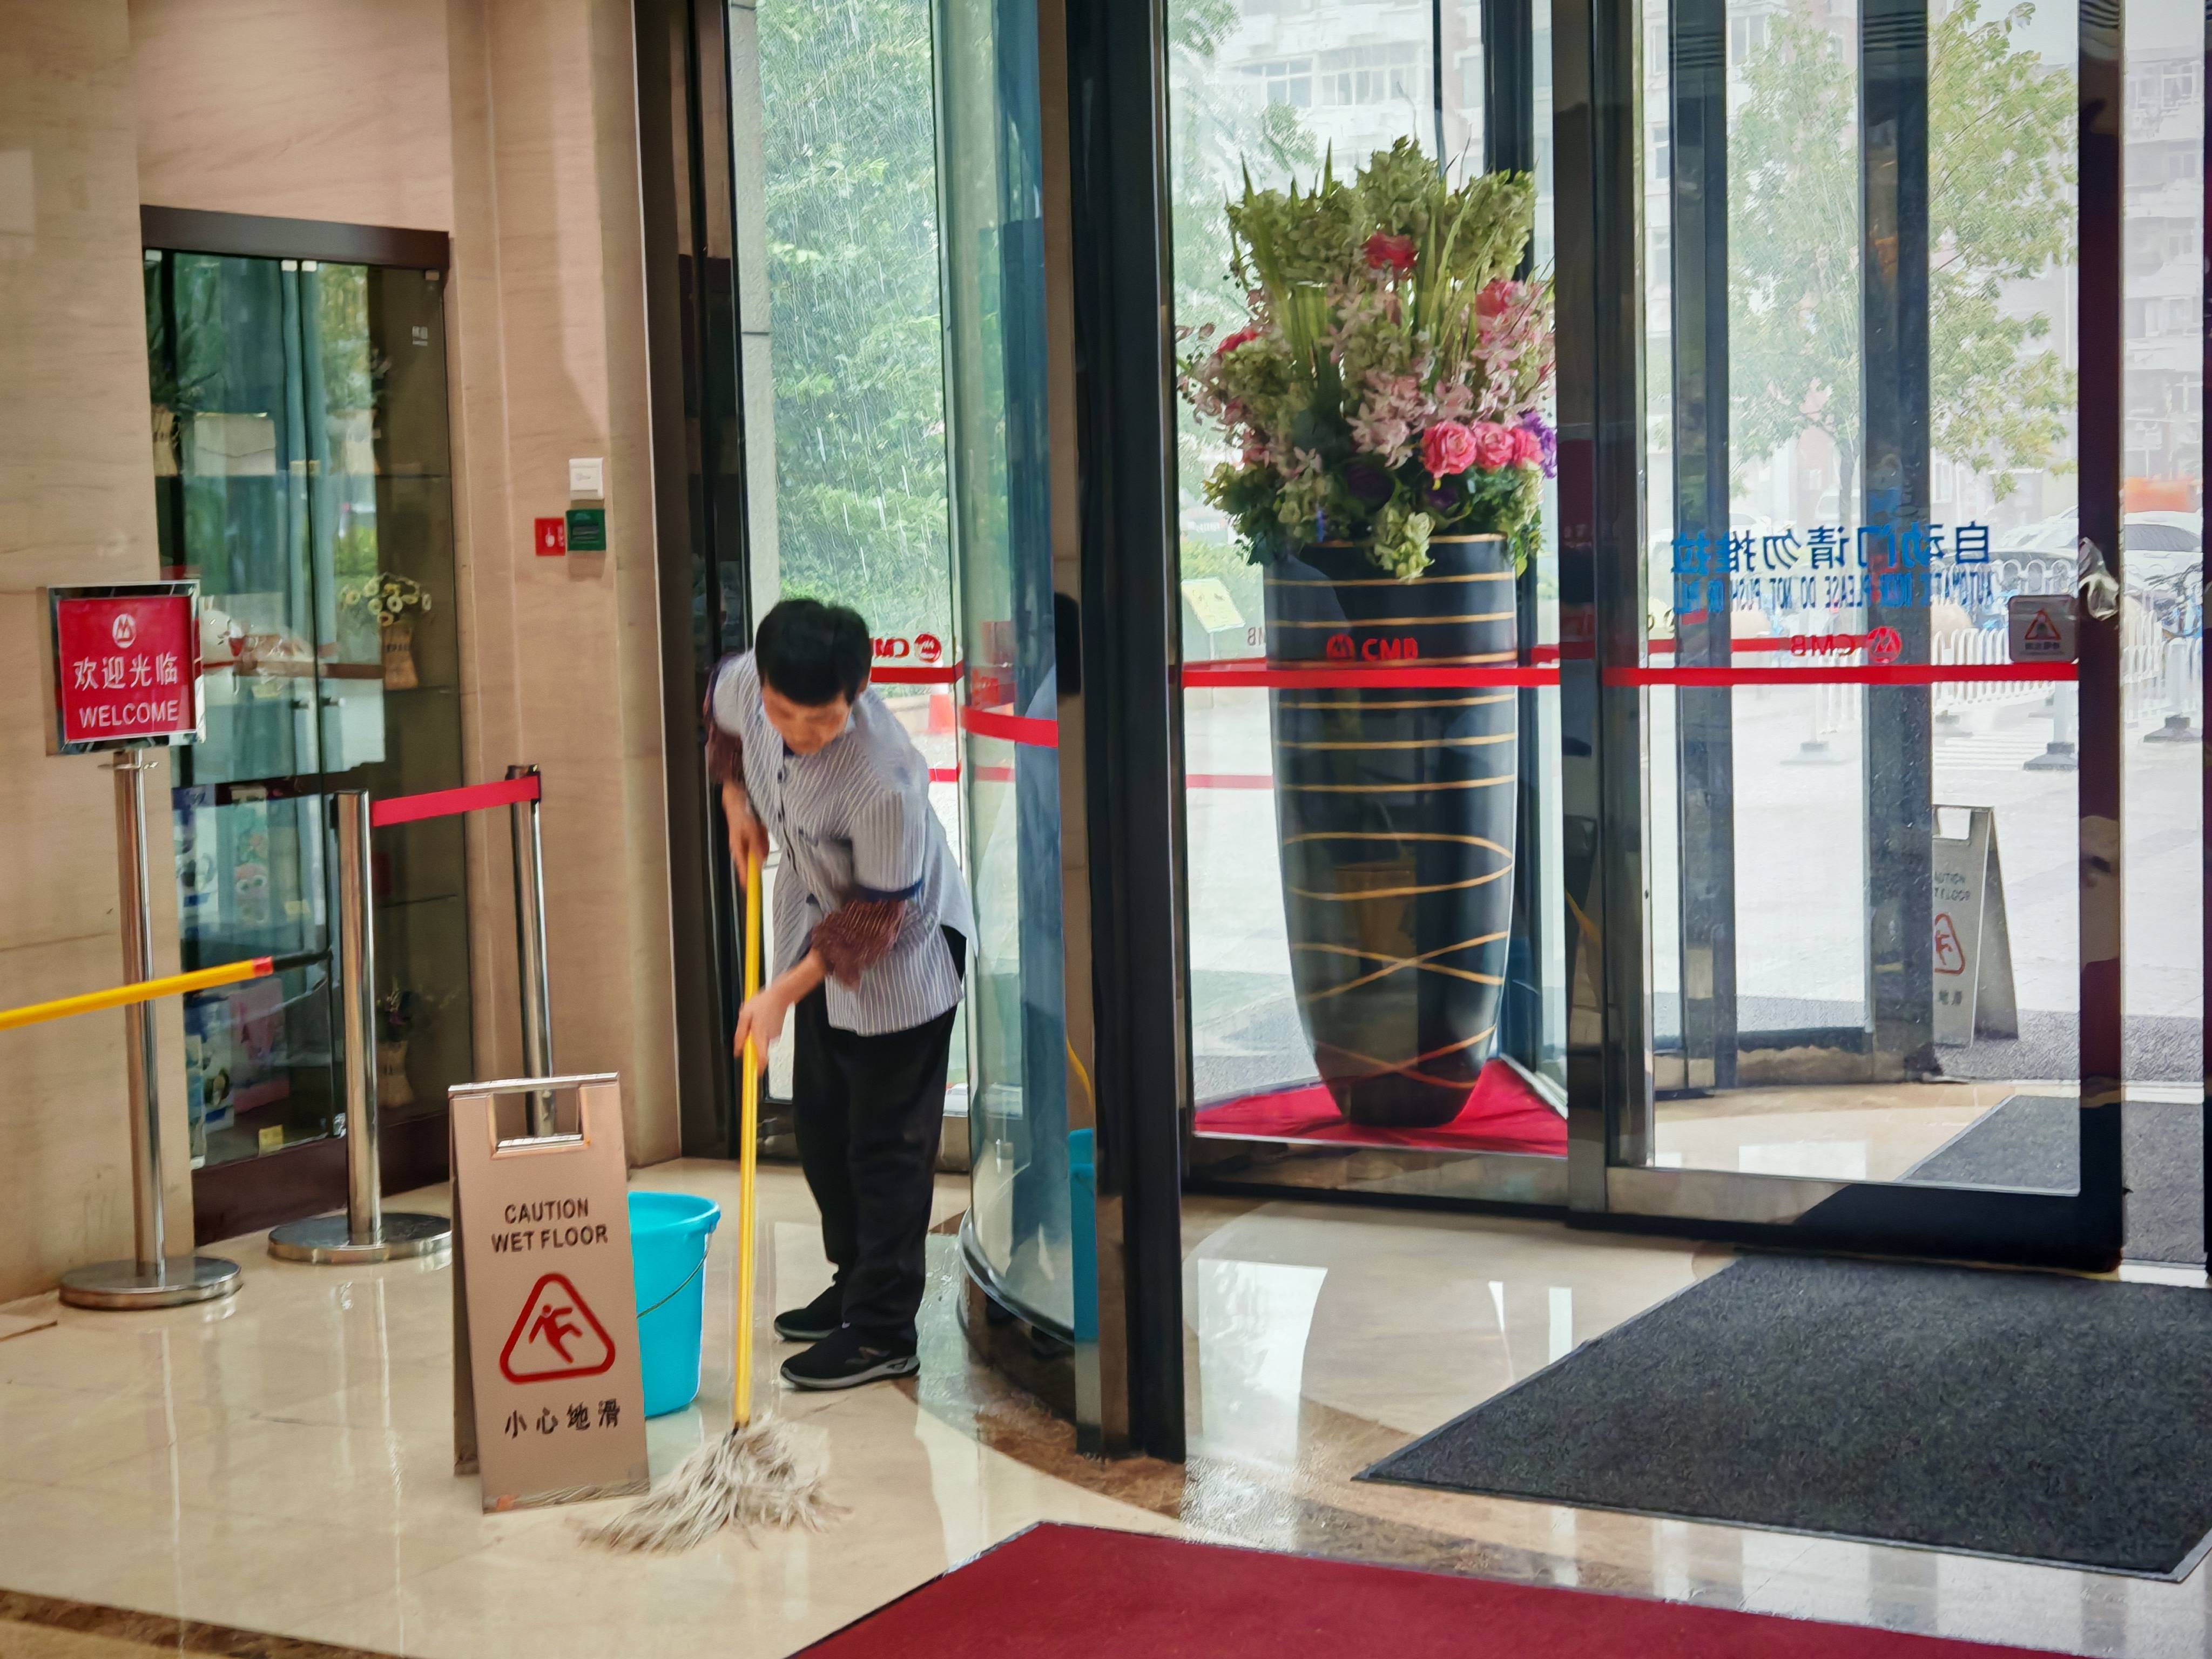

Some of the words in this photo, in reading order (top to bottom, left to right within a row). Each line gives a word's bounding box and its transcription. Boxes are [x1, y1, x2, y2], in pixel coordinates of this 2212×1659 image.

[73, 651, 178, 691] 欢迎光临
[79, 700, 178, 728] WELCOME
[504, 1197, 589, 1224] CAUTION
[491, 1231, 535, 1253] WET
[541, 1223, 608, 1250] FLOOR
[505, 1398, 621, 1440] 小心地滑
